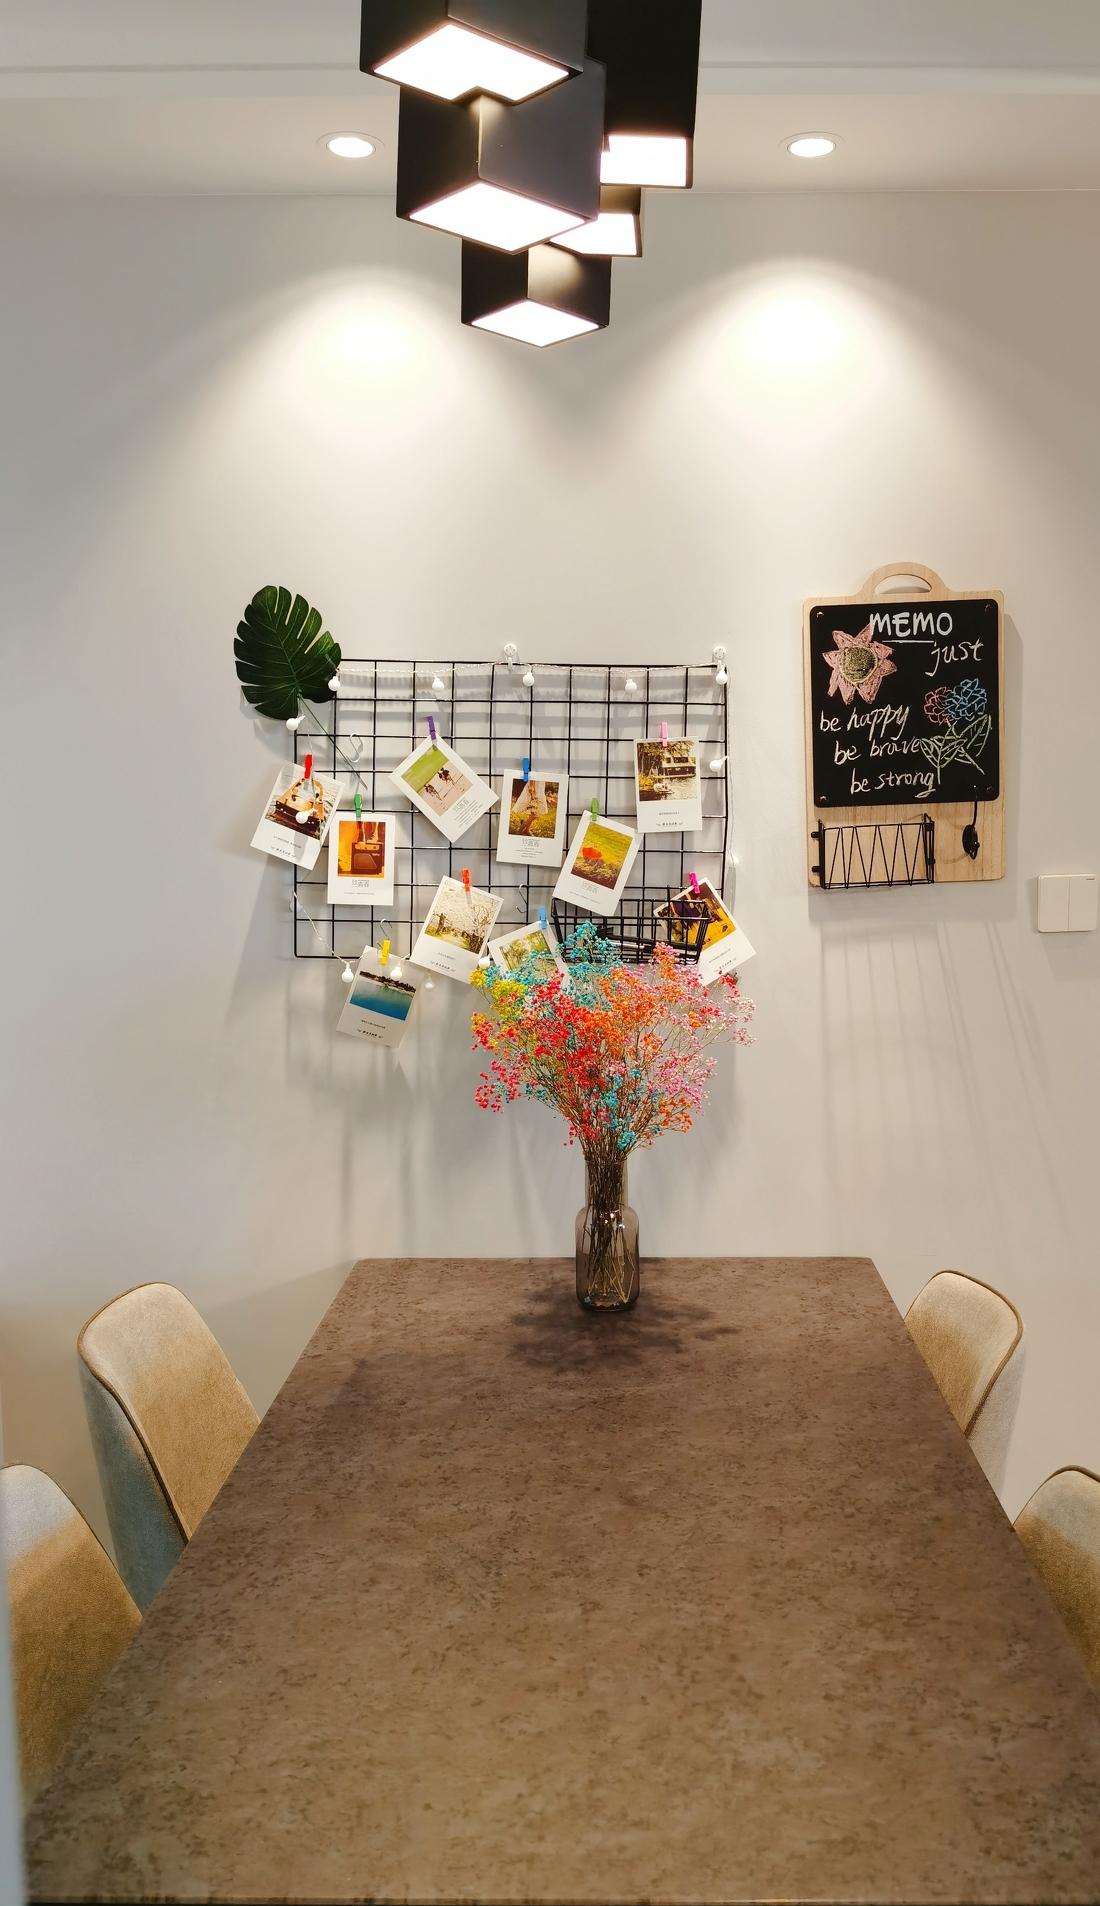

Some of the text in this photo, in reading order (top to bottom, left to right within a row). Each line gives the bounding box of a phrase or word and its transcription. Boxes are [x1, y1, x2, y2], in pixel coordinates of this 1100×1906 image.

[870, 612, 953, 637] MEMO
[925, 638, 984, 677] just
[820, 705, 910, 741] be happy
[834, 737, 921, 765] be brave
[850, 768, 936, 797] be strong
